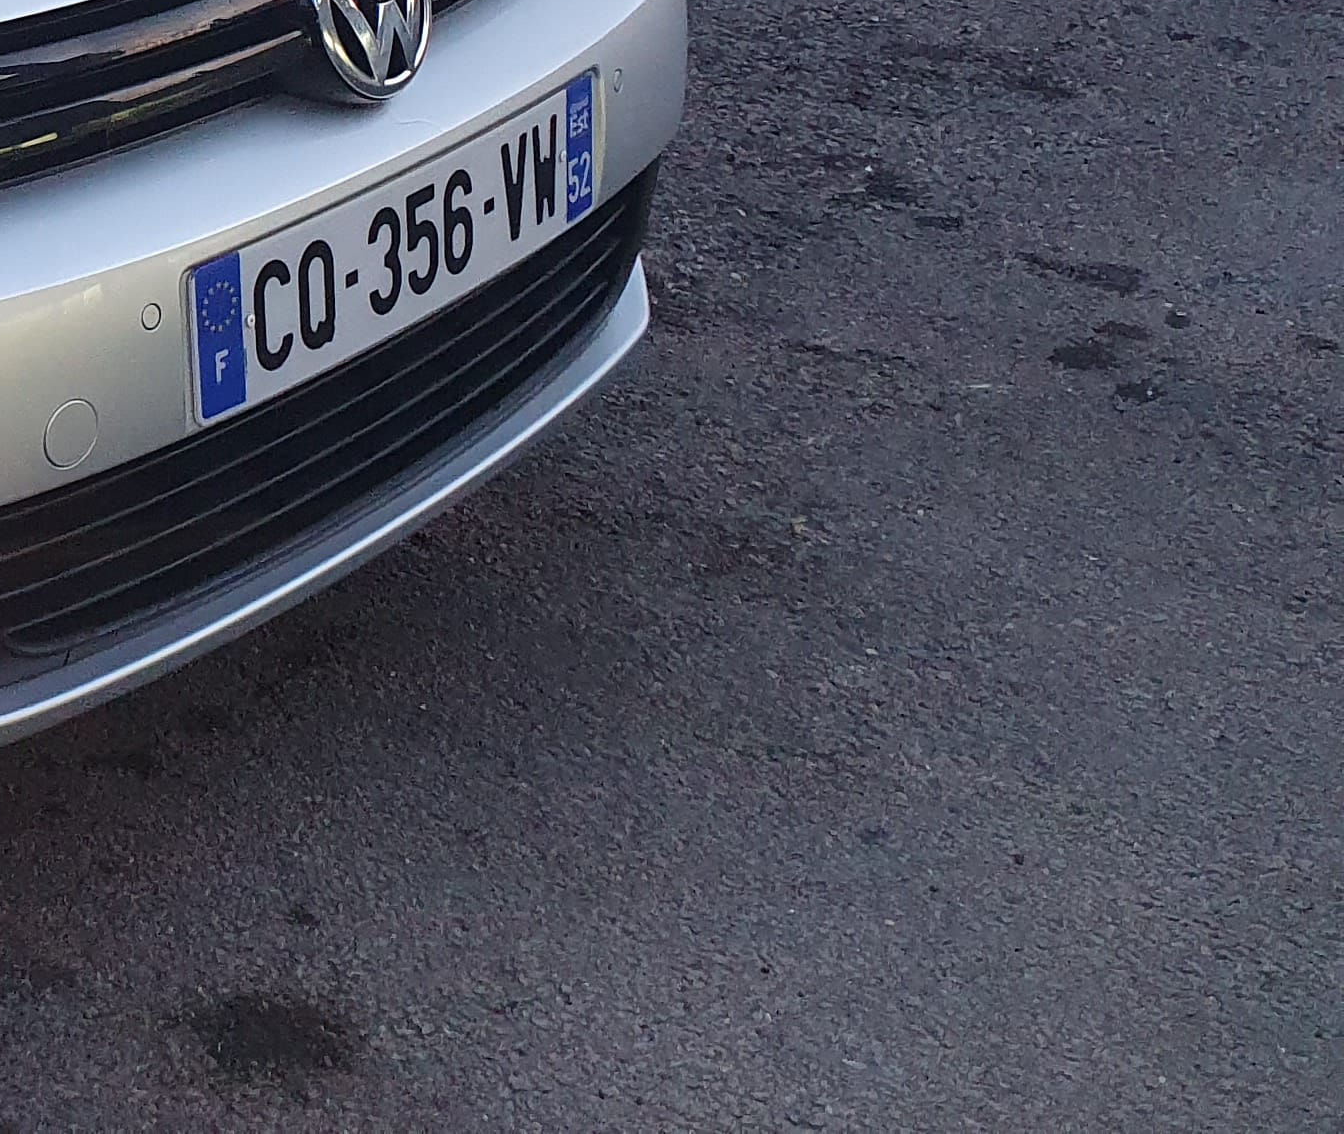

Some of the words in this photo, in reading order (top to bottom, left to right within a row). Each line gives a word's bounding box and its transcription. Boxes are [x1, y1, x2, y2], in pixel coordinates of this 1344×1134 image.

[567, 151, 591, 203] 52
[253, 113, 557, 372] CQ-356-VW
[215, 348, 230, 385] F
